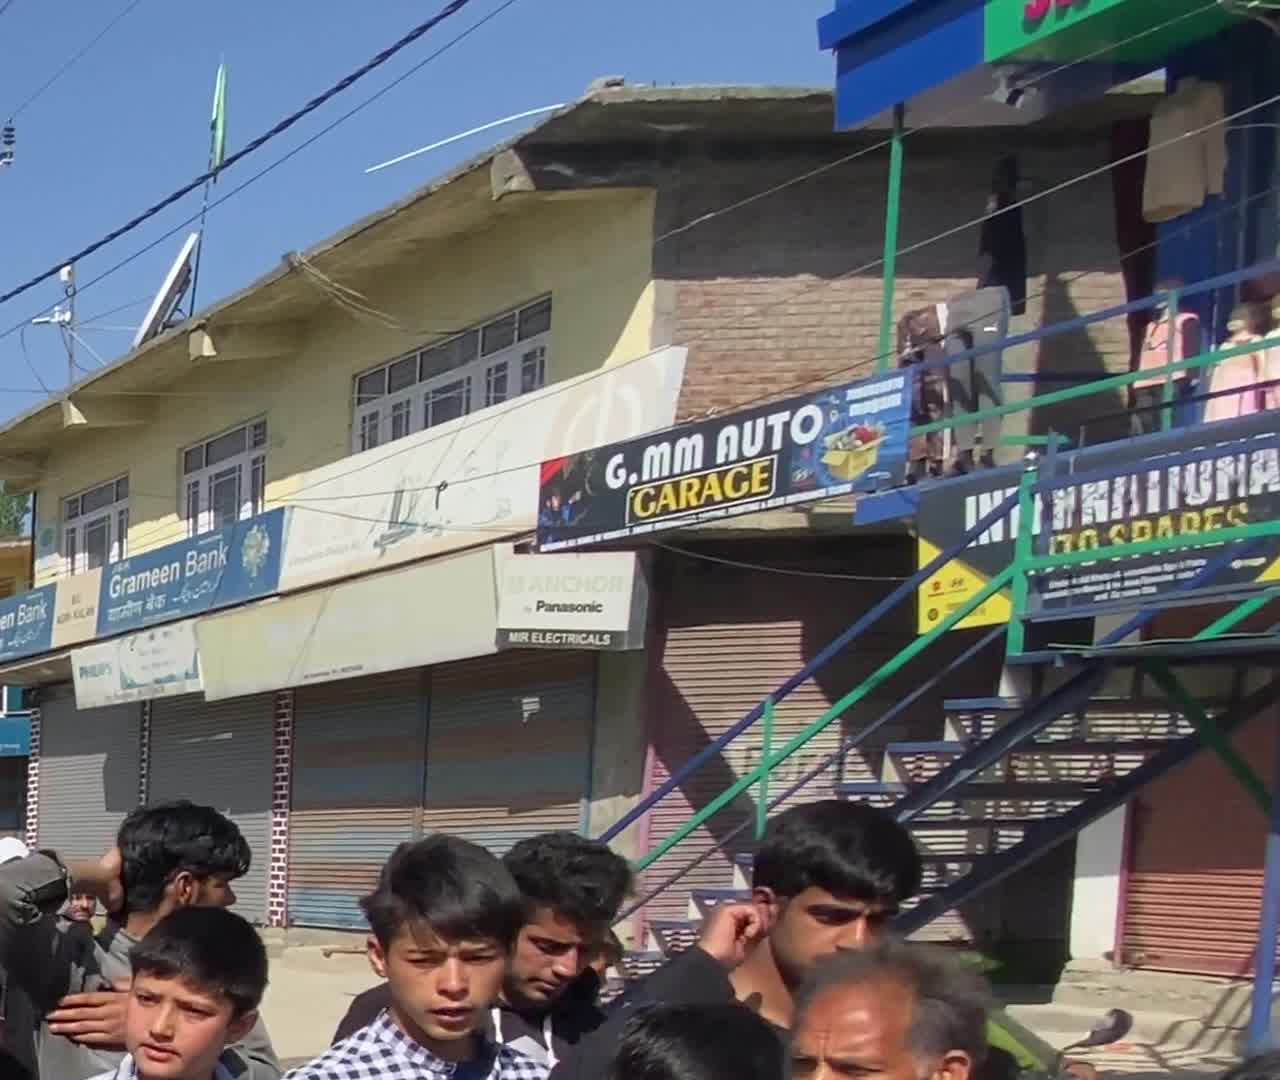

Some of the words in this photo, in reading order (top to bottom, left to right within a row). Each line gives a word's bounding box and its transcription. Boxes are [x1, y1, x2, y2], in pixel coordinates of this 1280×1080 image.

[605, 433, 704, 489] G.MM
[716, 403, 823, 465] AUTO
[631, 459, 770, 518] GARAGE
[109, 561, 180, 599] Grameen
[185, 540, 228, 577] Bank
[16, 599, 47, 626] Bank
[536, 600, 603, 614] Panasonic
[509, 632, 529, 643] MIR
[531, 632, 611, 646] ELECTRICALS
